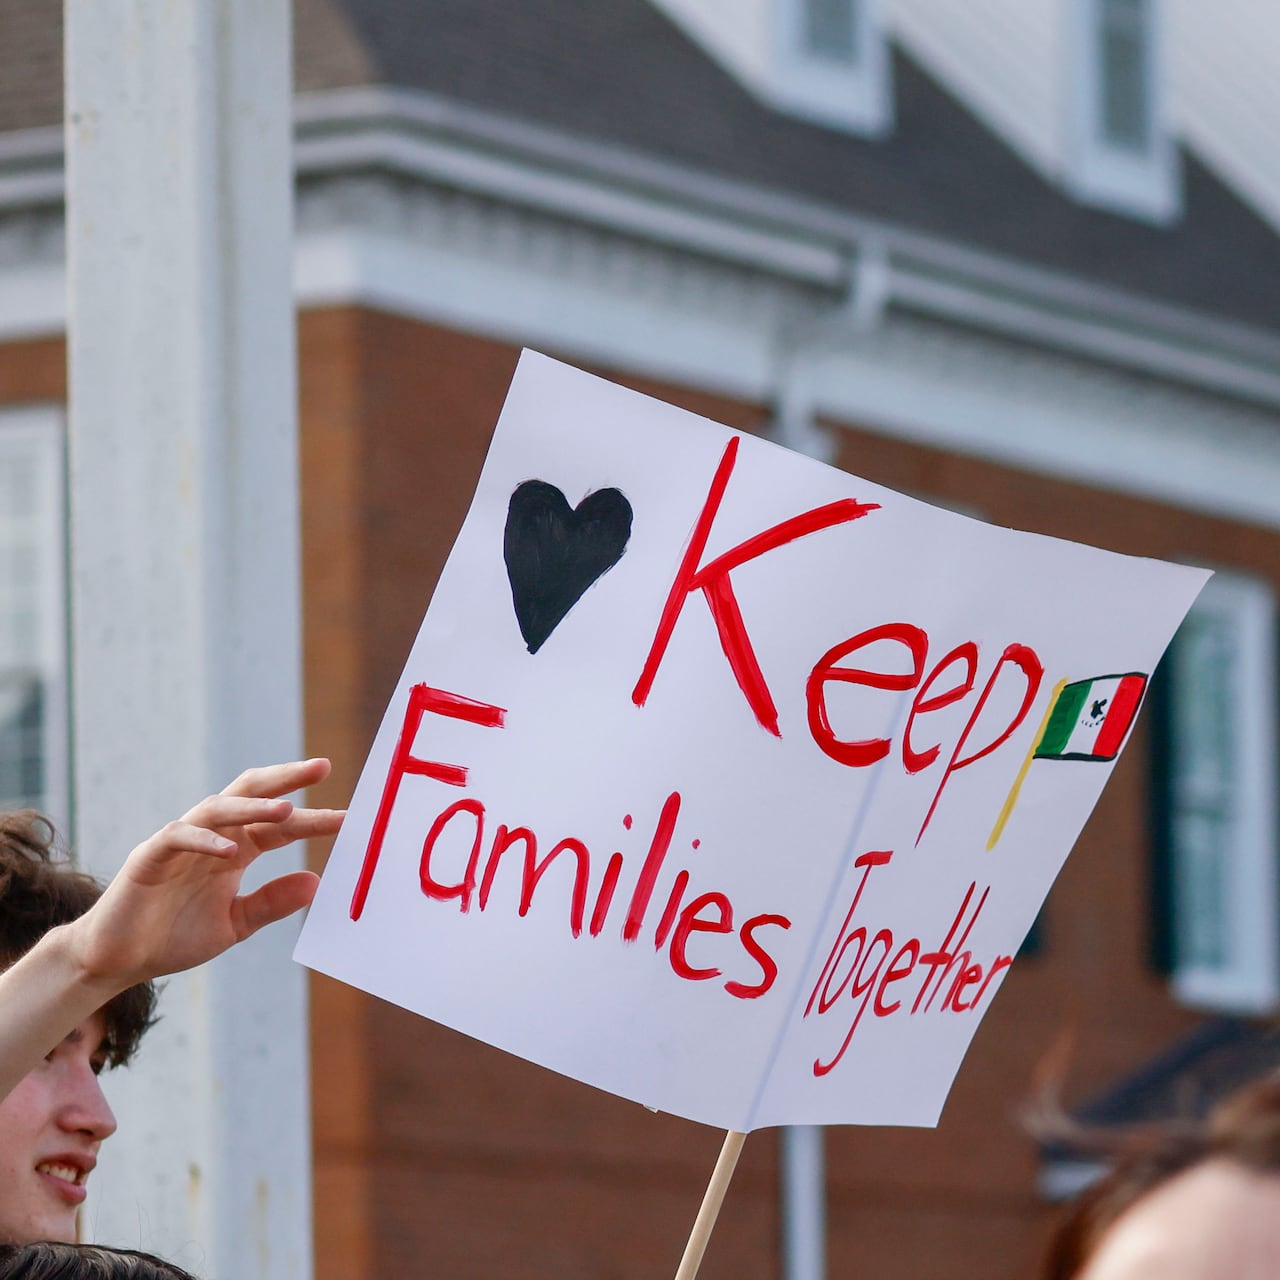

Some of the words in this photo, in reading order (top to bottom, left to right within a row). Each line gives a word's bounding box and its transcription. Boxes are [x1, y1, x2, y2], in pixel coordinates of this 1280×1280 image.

[632, 436, 1044, 848] Keep
[349, 682, 791, 999] Families
[802, 850, 1011, 1078] Together
